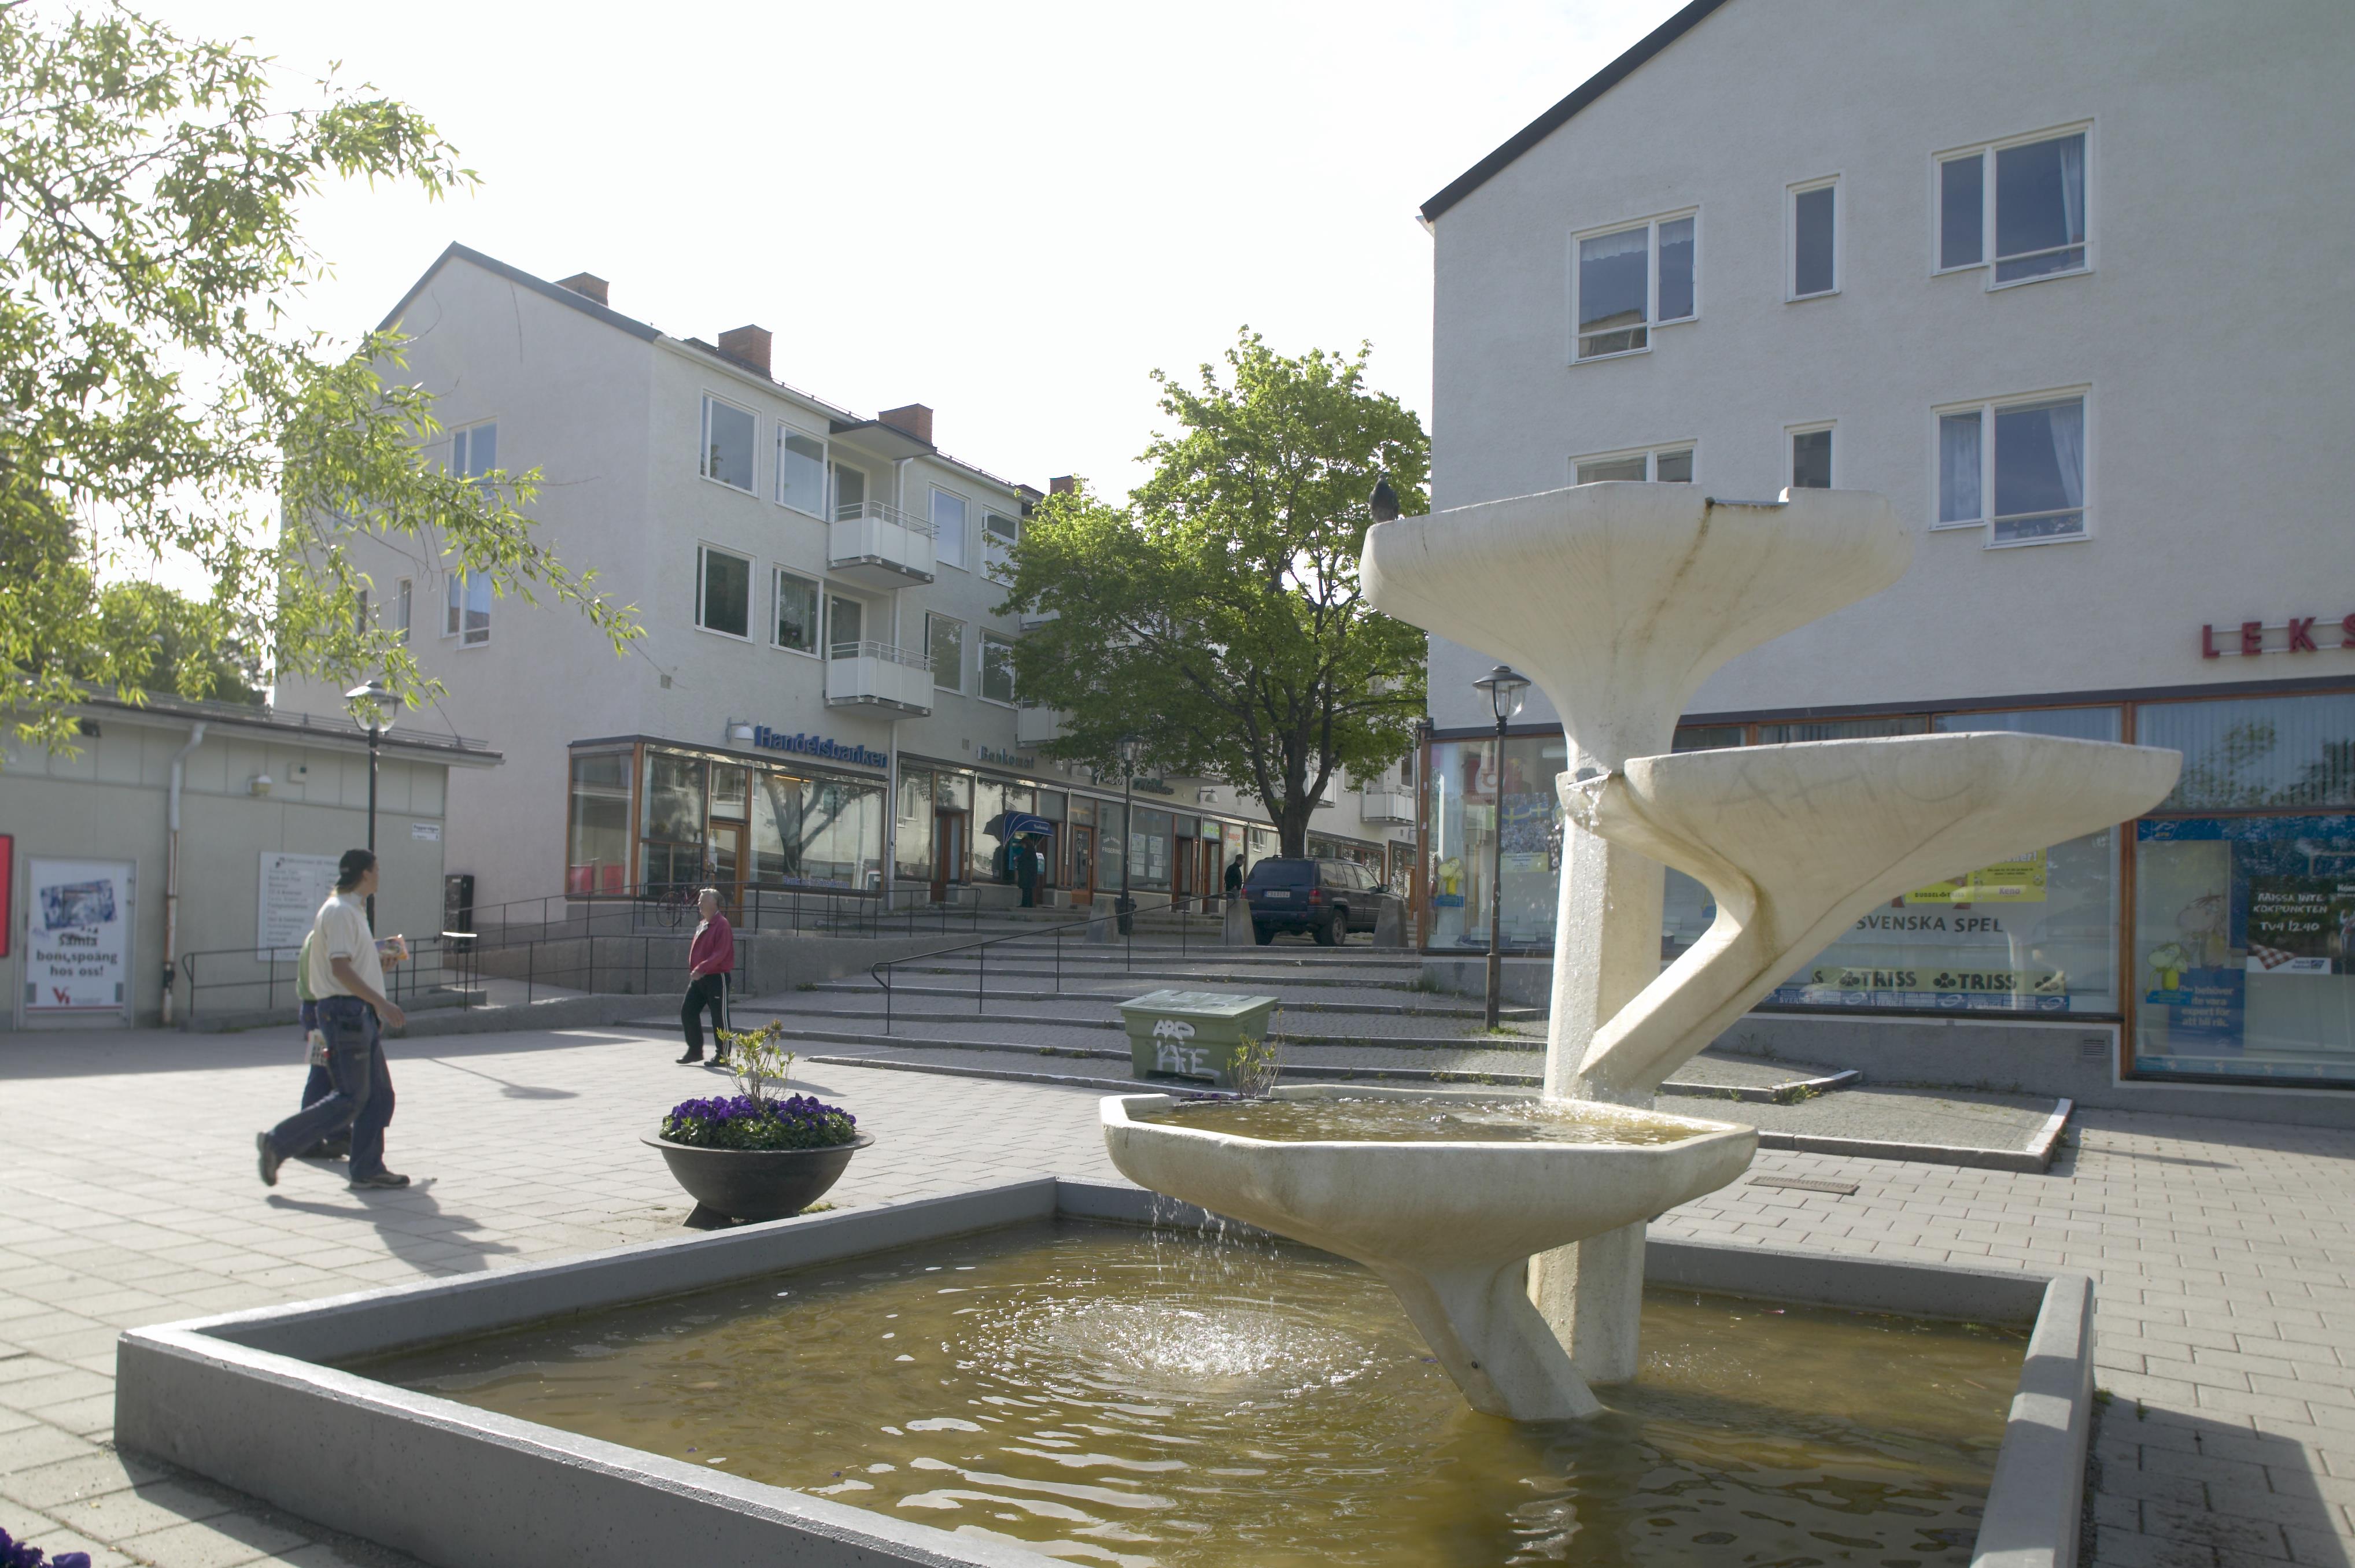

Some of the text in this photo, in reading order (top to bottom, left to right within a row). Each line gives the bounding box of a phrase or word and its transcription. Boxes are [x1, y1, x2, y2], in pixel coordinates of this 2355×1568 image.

[754, 726, 888, 768] Handelsbanken
[977, 746, 1034, 769] Bankomat
[1999, 887, 2021, 895] Keno
[2298, 893, 2324, 902] INTE
[1856, 915, 2003, 933] SVENSKA SPEL
[50, 964, 104, 976] hos oss!
[1861, 971, 1917, 987] TRISS
[1958, 974, 2017, 990] TRISS
[2195, 985, 2234, 995] behöver
[2181, 1007, 2230, 1016] expert för
[2182, 1017, 2230, 1027] att bli rik.
